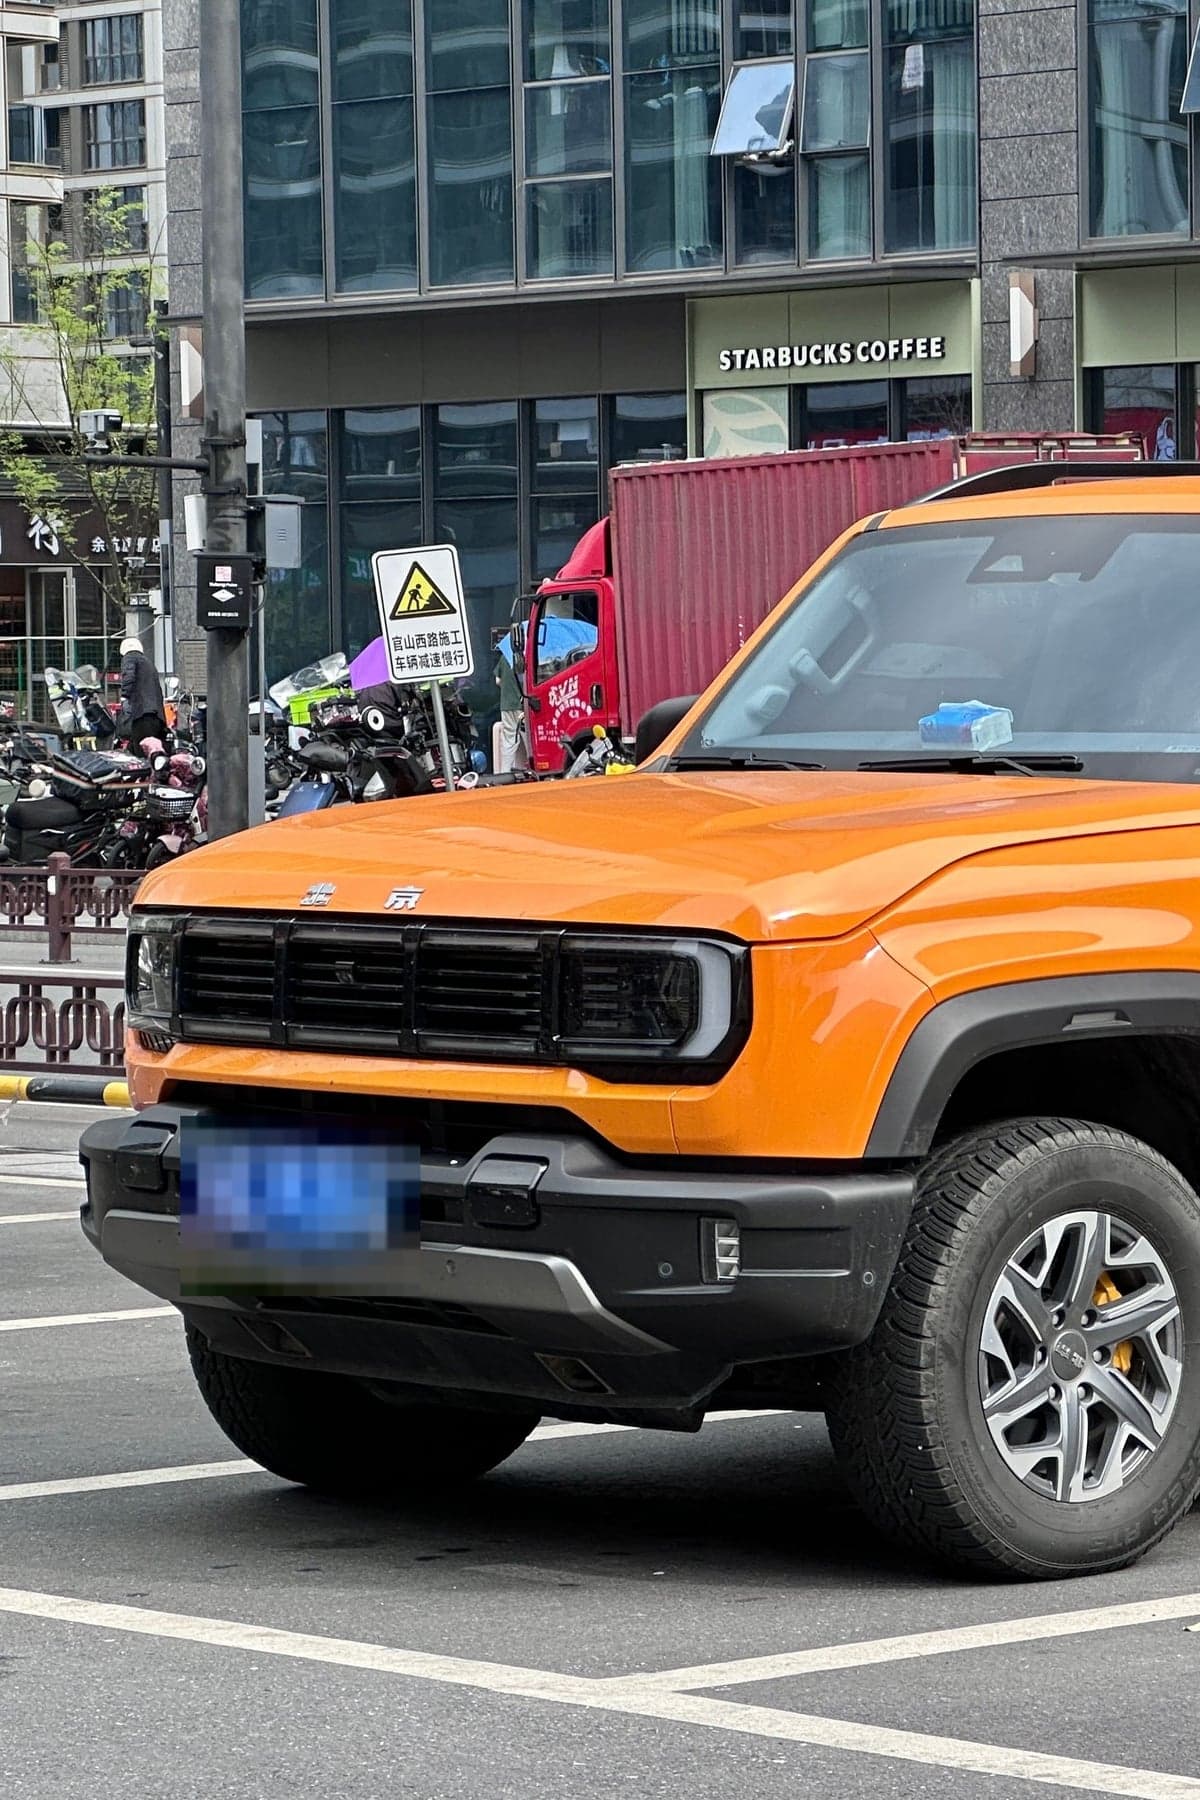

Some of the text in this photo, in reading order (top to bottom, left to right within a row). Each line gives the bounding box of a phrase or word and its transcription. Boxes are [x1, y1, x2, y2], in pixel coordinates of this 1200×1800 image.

[719, 336, 943, 371] STARBUCKS COFFEE
[392, 630, 463, 652] 官山西路施工
[394, 650, 465, 672] 车辆减速慢行
